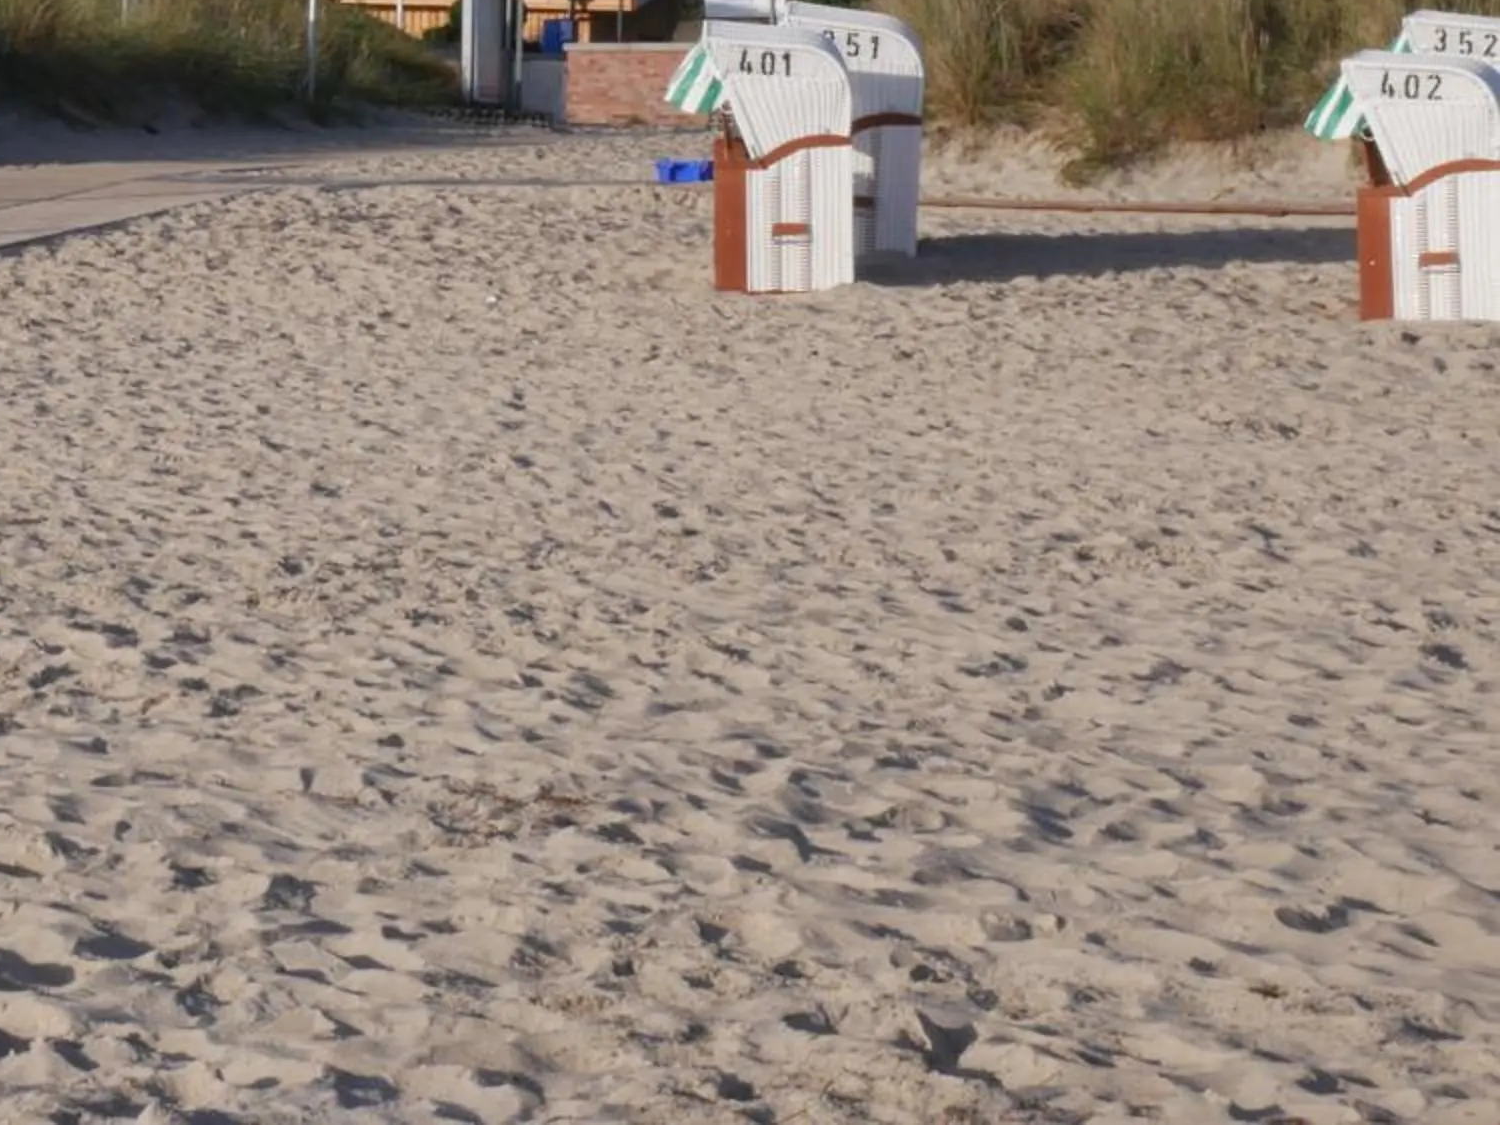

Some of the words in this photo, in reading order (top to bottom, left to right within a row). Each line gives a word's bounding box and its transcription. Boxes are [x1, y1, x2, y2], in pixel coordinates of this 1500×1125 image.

[1434, 26, 1498, 57] 352
[740, 49, 791, 77] 401
[1381, 70, 1443, 100] 402
